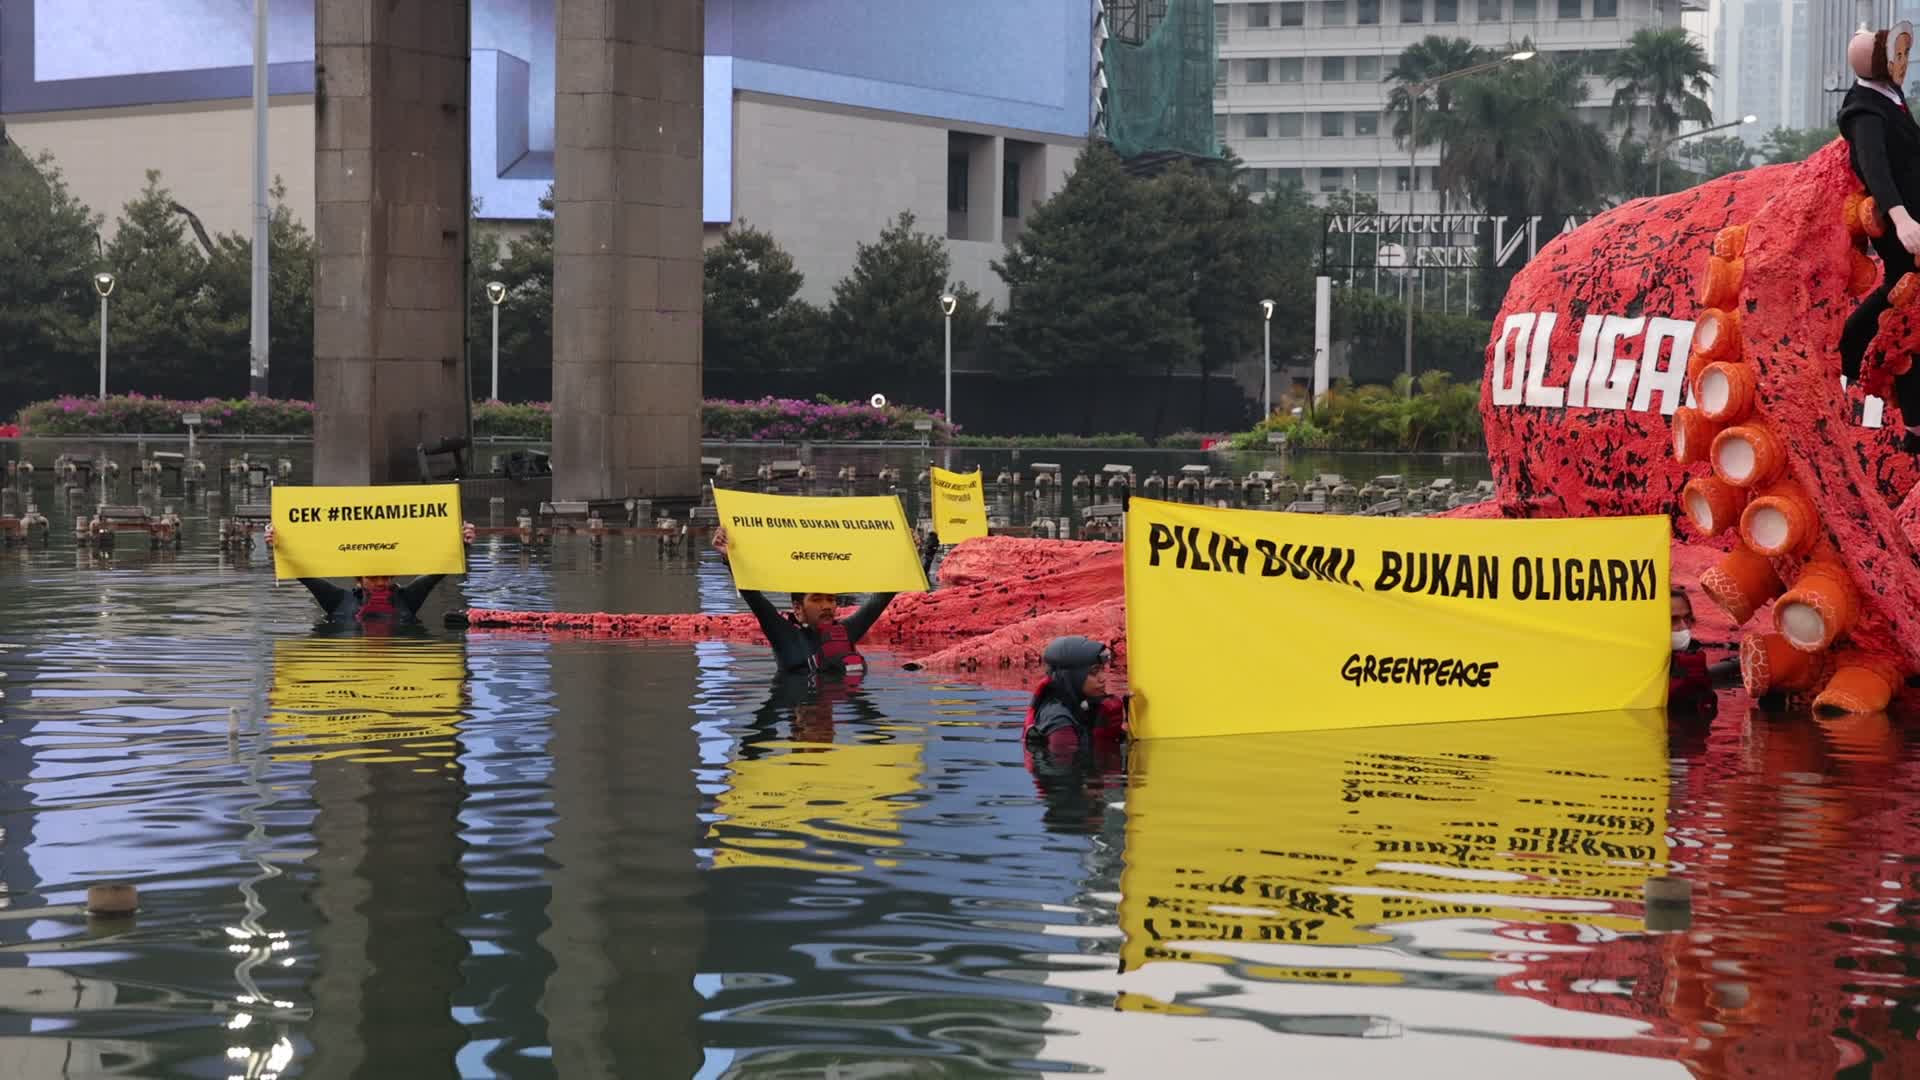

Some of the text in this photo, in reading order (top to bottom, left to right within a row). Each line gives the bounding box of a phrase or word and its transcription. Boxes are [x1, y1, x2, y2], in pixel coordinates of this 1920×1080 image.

[1492, 312, 1697, 416] OLIGA
[289, 503, 447, 523] CEK #REKAMJEJAK
[732, 516, 895, 531] PILIH BUMI BUKAN OLIGARKI
[338, 542, 399, 552] GREENPEACE
[791, 551, 852, 561] GREENPEACE
[1149, 523, 1249, 574] PILIH
[1375, 550, 1499, 599] BUKAN
[1512, 556, 1656, 601] OLIGARKI
[1341, 654, 1498, 687] GREENPEACE
